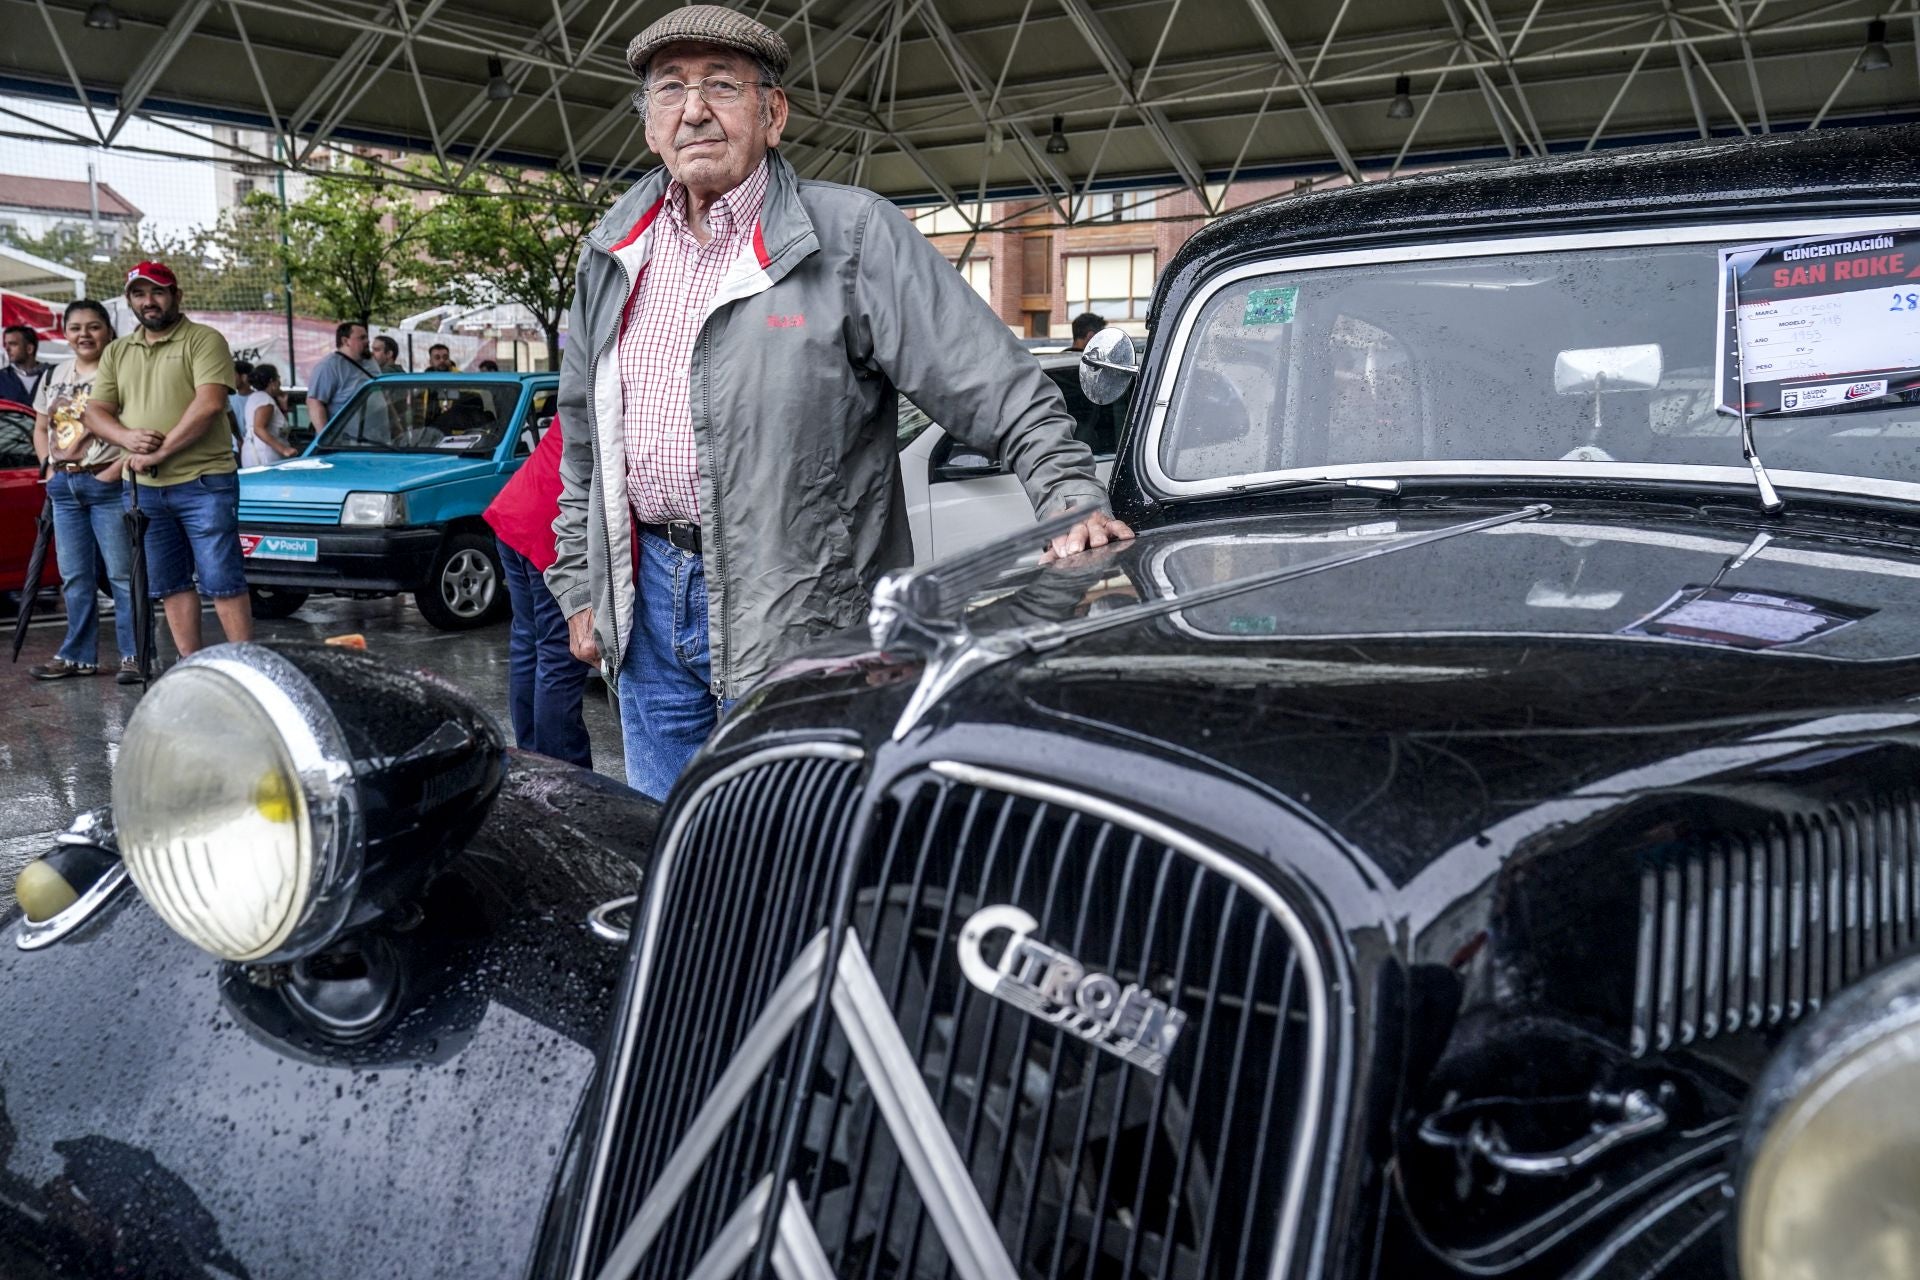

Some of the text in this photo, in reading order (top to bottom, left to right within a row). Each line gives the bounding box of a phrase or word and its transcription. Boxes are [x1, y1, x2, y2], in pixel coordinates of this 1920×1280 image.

[1783, 236, 1894, 261] CONCENTRACIÓN
[1773, 253, 1905, 288] SAN ROKE
[1889, 293, 1919, 312] 28
[1755, 309, 1778, 317] MARCA
[1778, 319, 1806, 327] MODELO
